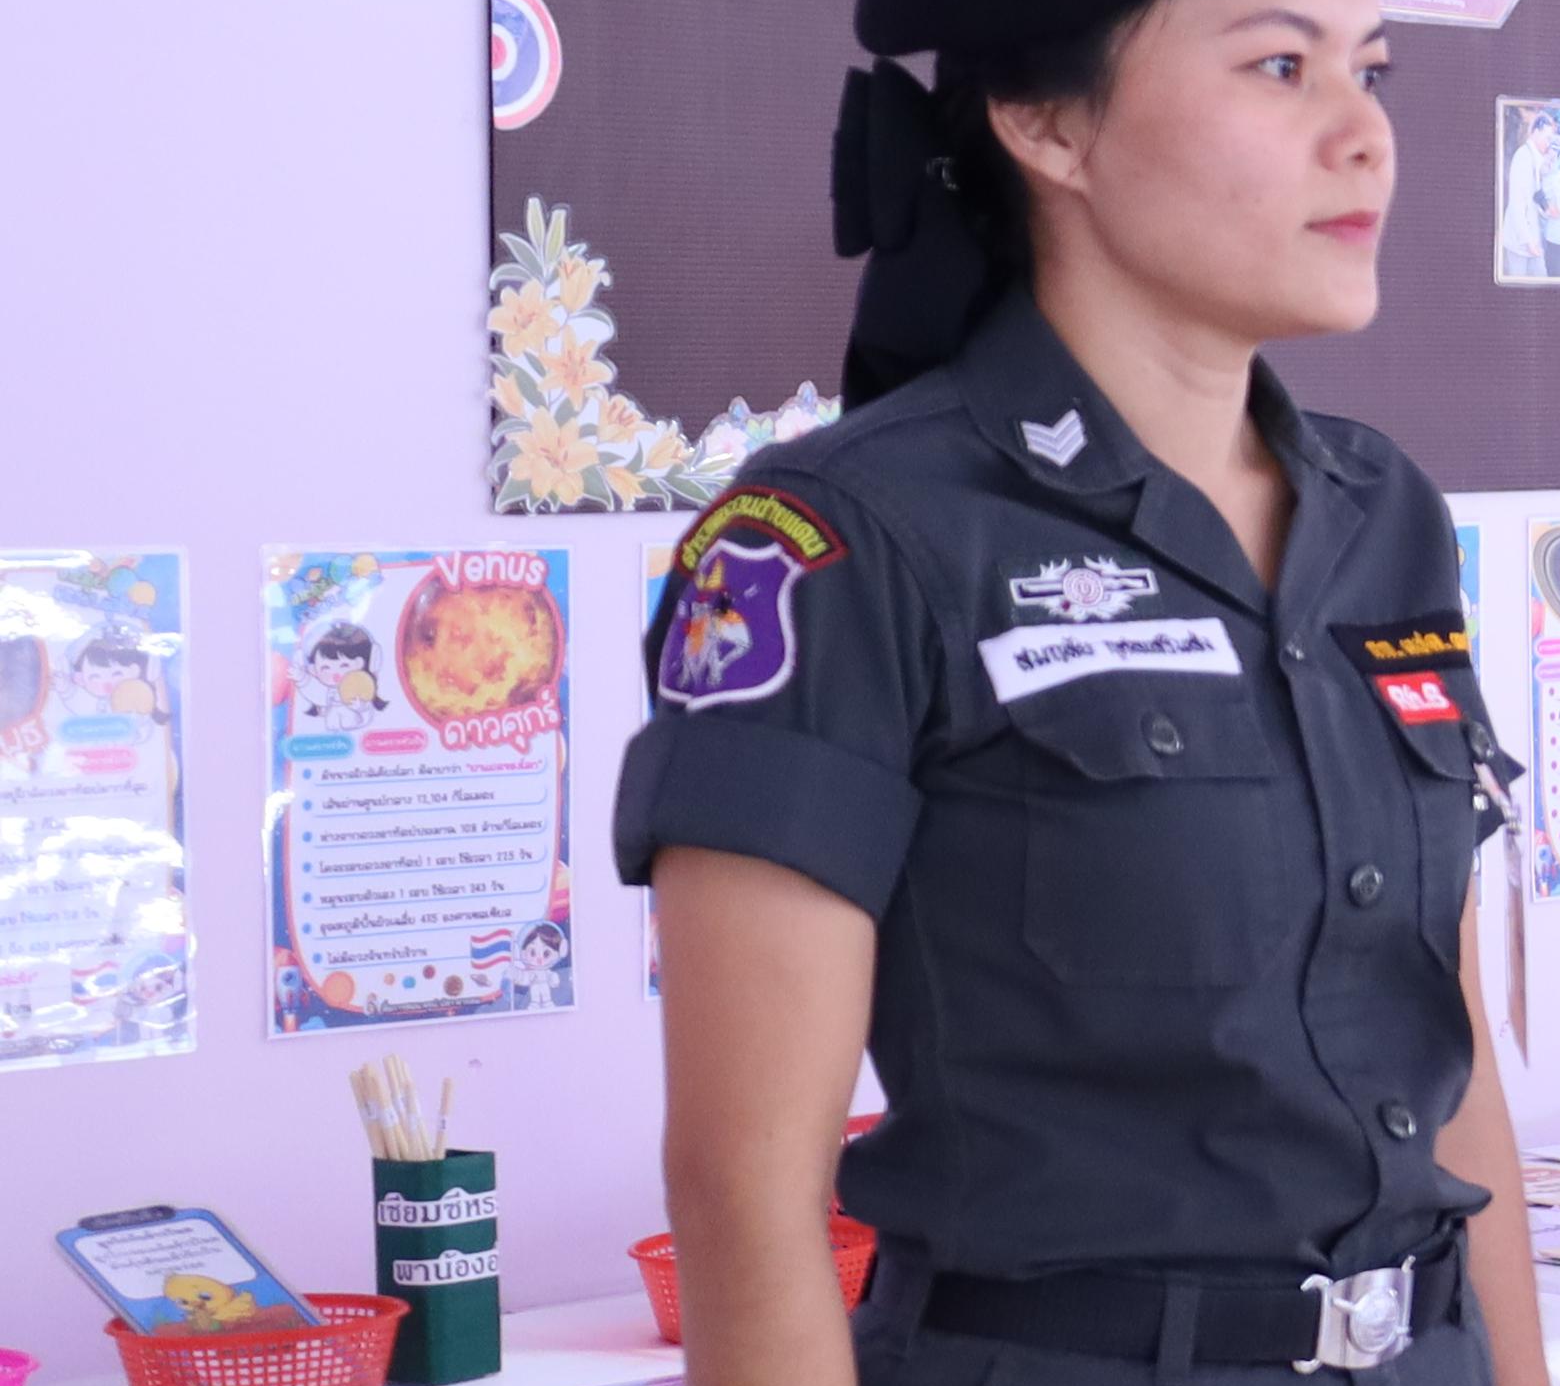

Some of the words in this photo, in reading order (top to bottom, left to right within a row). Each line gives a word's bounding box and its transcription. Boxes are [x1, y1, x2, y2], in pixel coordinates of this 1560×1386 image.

[435, 551, 546, 586] Venus
[444, 687, 562, 749] ดาวศุกร์
[379, 1191, 499, 1224] เซียมซีหร
